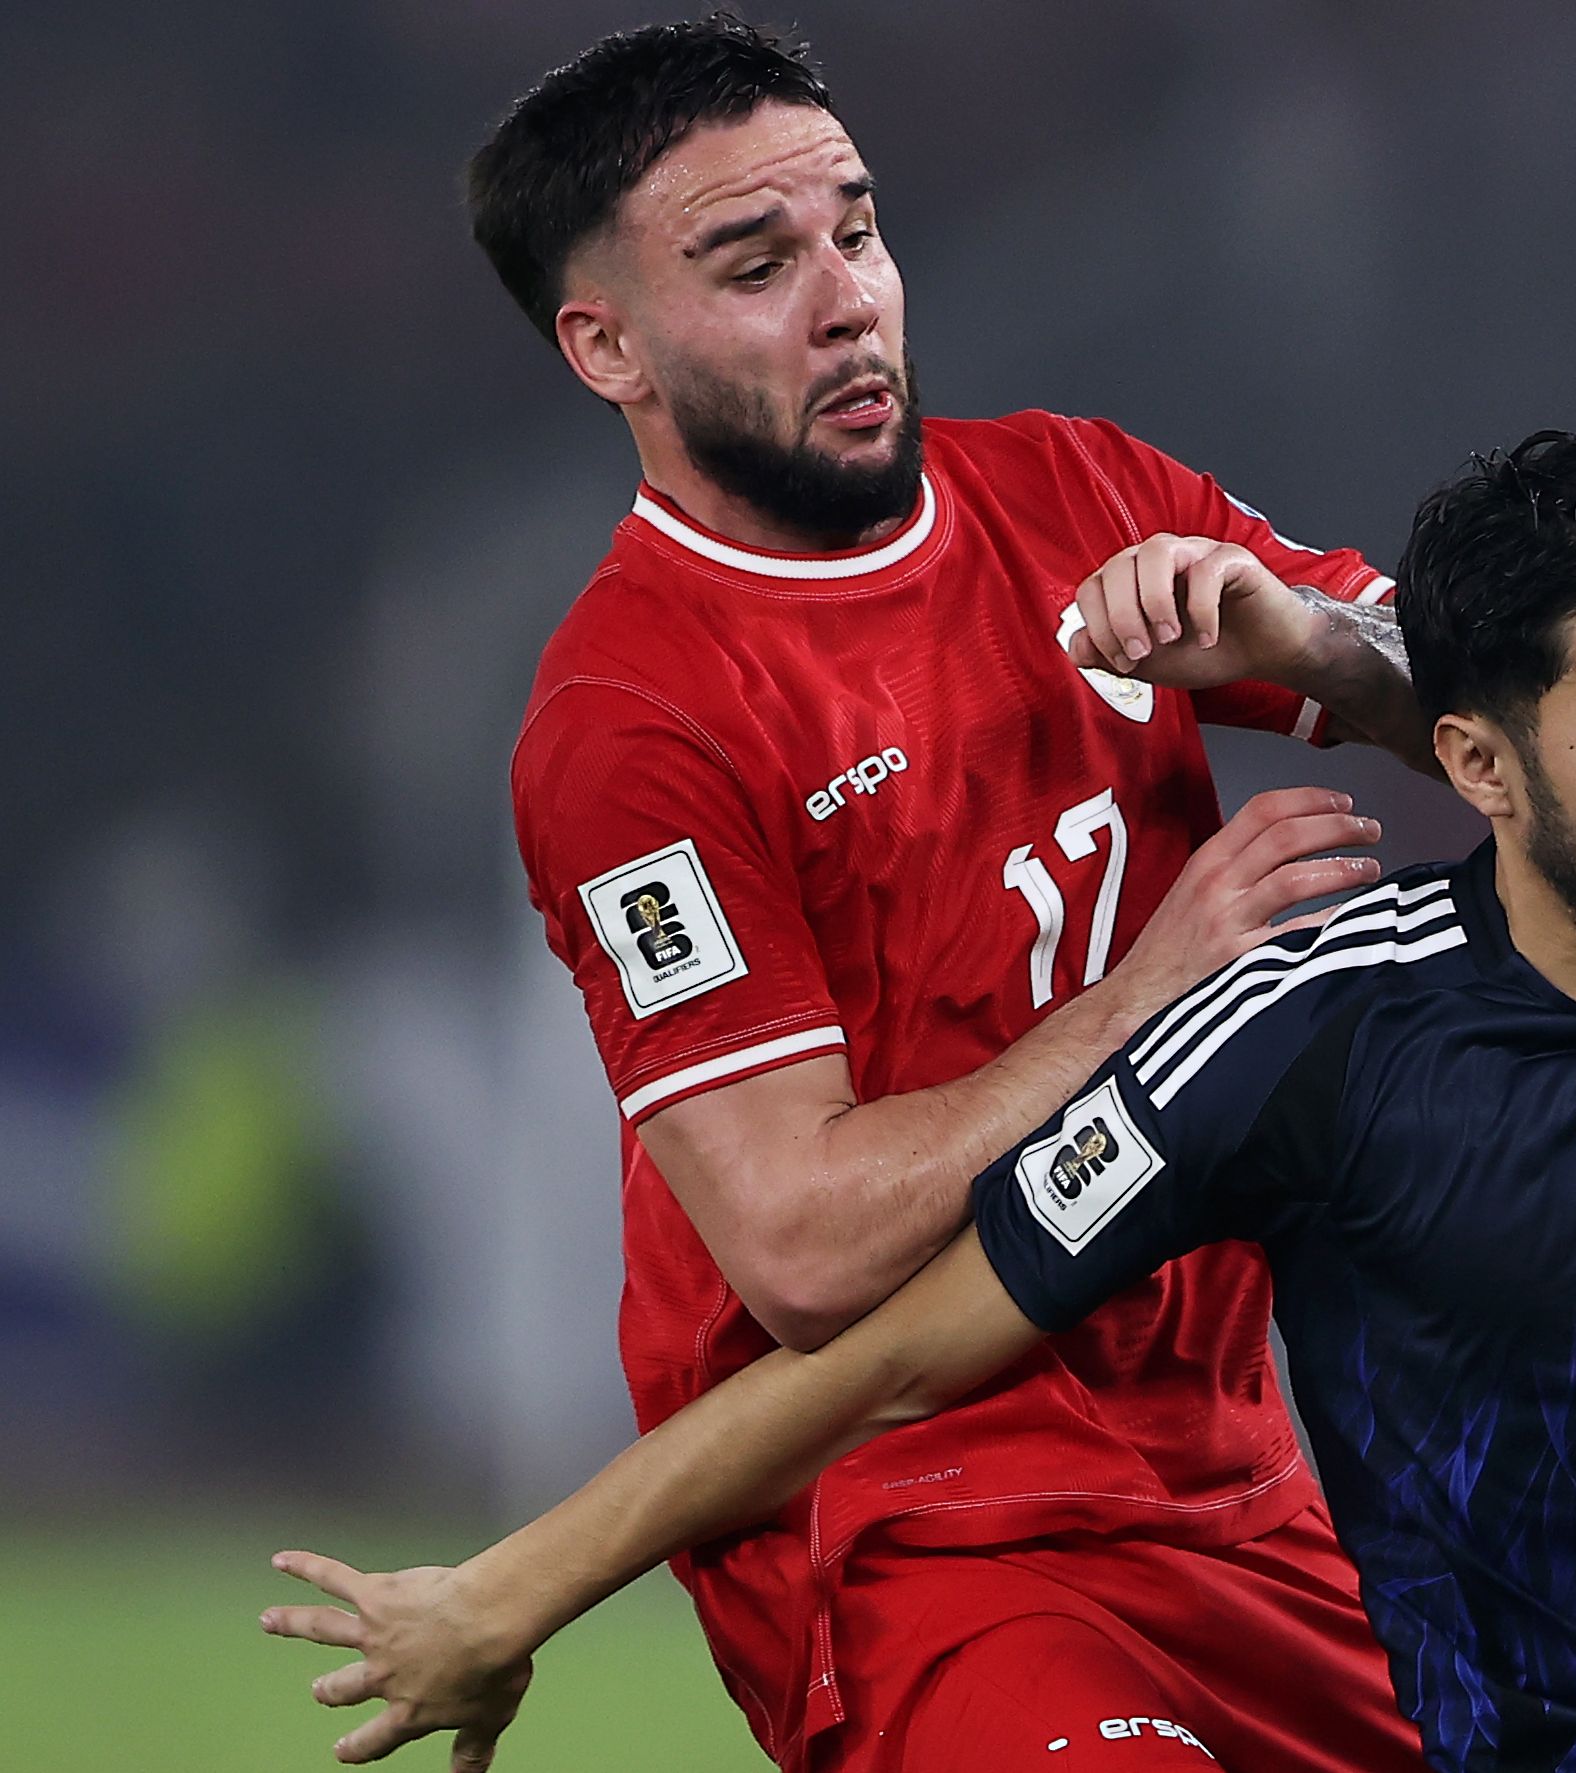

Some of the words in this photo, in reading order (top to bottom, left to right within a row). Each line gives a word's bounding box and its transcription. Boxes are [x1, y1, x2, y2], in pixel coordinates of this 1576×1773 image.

[806, 747, 908, 820] erspo
[1003, 786, 1127, 1010] 17
[653, 958, 701, 983] QUALIFIERS
[654, 945, 682, 962] FIFA
[1043, 1171, 1068, 1212] LIFIERS
[1053, 1165, 1071, 1190] FIFA
[1099, 1717, 1216, 1760] ersp
